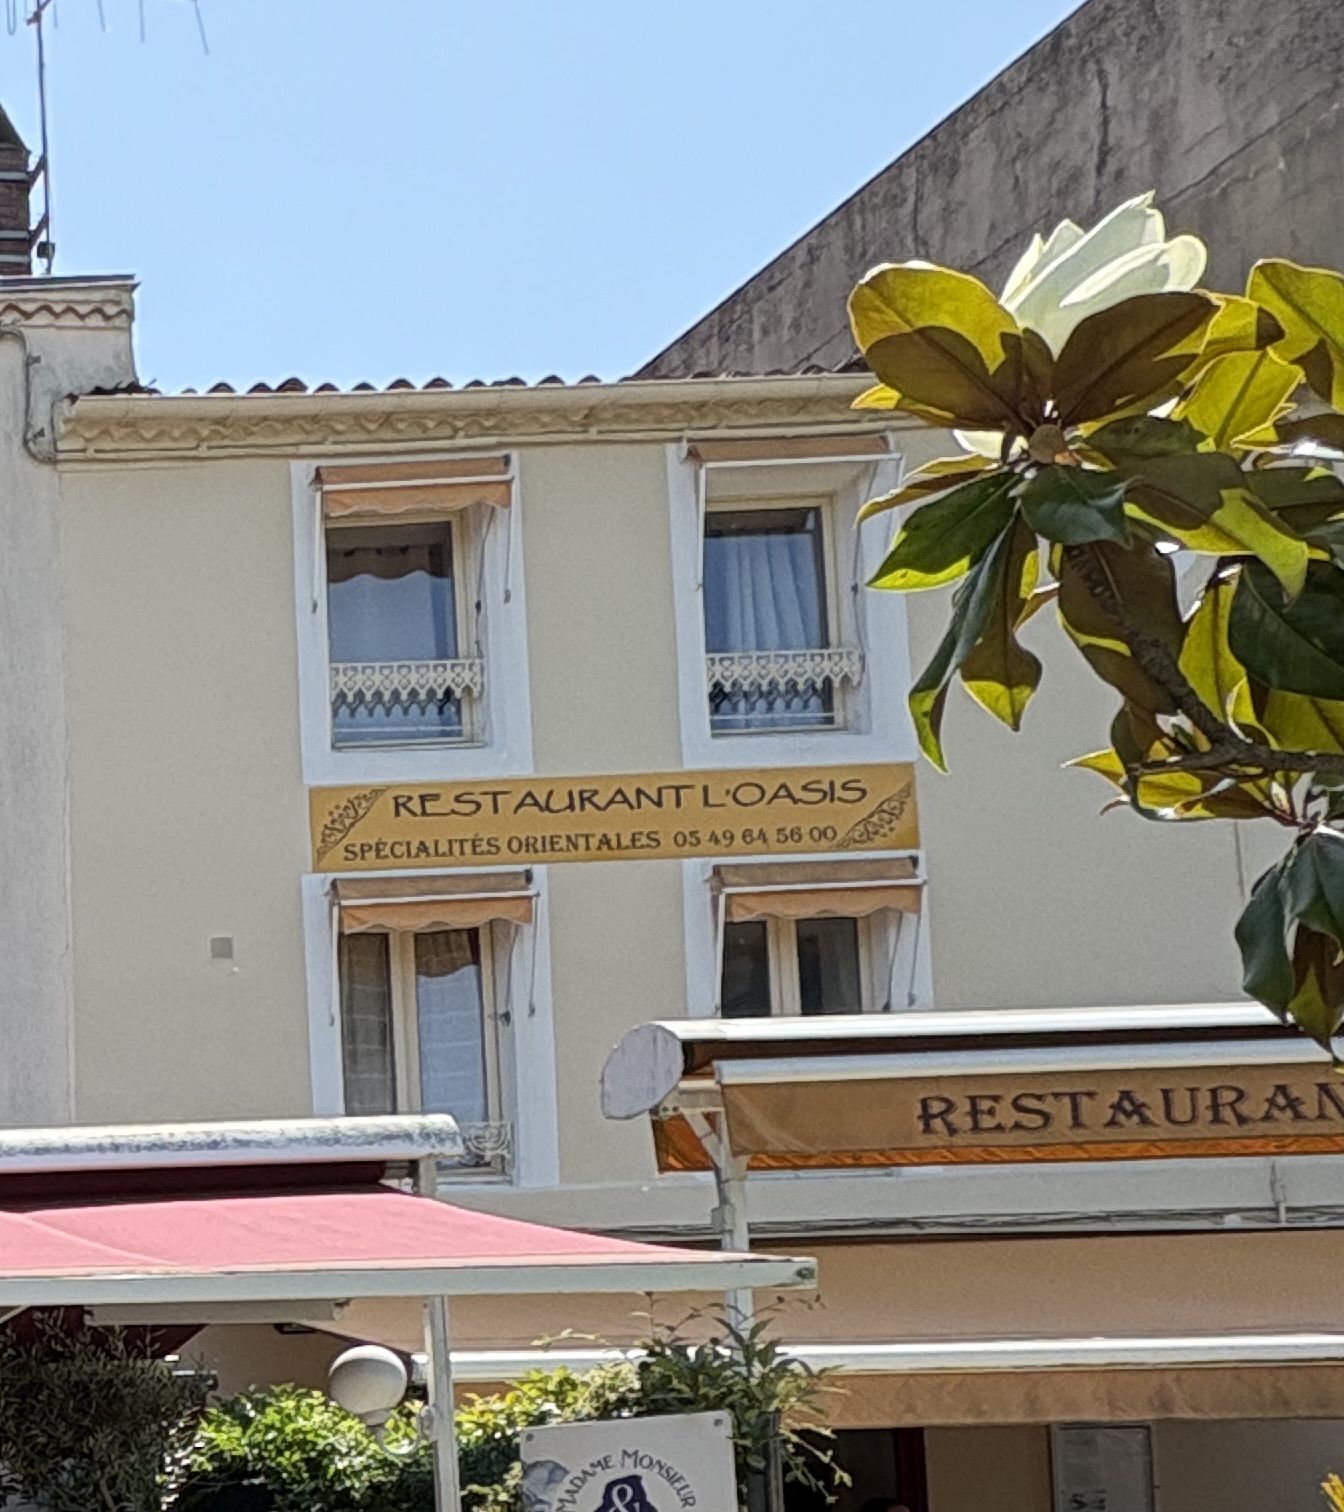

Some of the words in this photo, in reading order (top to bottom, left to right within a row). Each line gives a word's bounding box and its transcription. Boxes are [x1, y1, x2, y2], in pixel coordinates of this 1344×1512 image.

[392, 784, 696, 818] RESTAURANT
[702, 778, 868, 808] L'OASIS
[343, 832, 503, 862] SPÉCIALITÉS
[506, 830, 662, 856] ORIENTALES
[672, 830, 702, 848] 05
[707, 828, 736, 848] 49
[741, 827, 769, 846] 64
[775, 826, 803, 844] 56
[808, 825, 838, 843] 00
[620, 1448, 697, 1510] MONSIEUR
